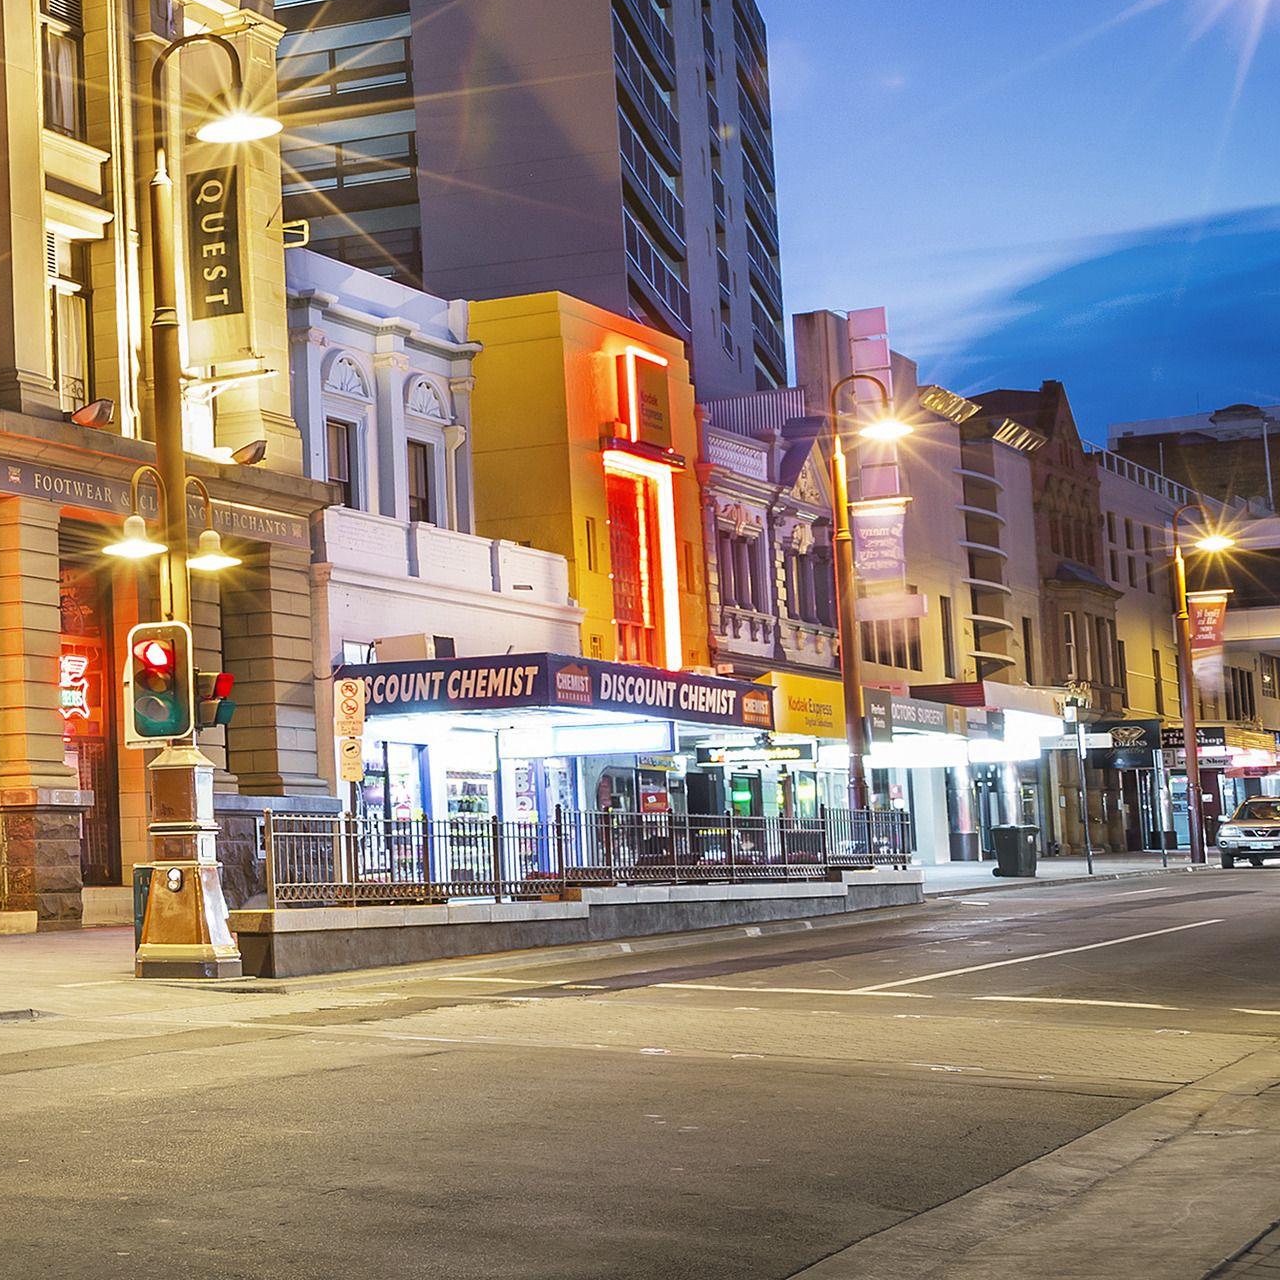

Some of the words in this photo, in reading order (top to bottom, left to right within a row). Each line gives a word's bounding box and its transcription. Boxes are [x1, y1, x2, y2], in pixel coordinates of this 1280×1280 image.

[195, 179, 229, 306] QUEST
[34, 472, 113, 504] FOOTWEAR
[120, 491, 130, 507] &
[214, 509, 288, 537] MERCHANTS
[344, 671, 444, 704] SCOUNT
[447, 666, 539, 699] CHEMIST
[556, 672, 589, 692] CHEMIST
[600, 672, 676, 708] DISCOUNT
[679, 684, 737, 715] CHEMIST
[743, 697, 769, 715] CHEMIST
[788, 696, 808, 712] Kodak
[808, 698, 833, 716] Express
[870, 703, 886, 716] Perfect
[891, 703, 917, 722] OCTORS
[918, 706, 944, 727] SURGERY
[873, 717, 886, 729] Prints
[1114, 739, 1148, 747] OLLINS
